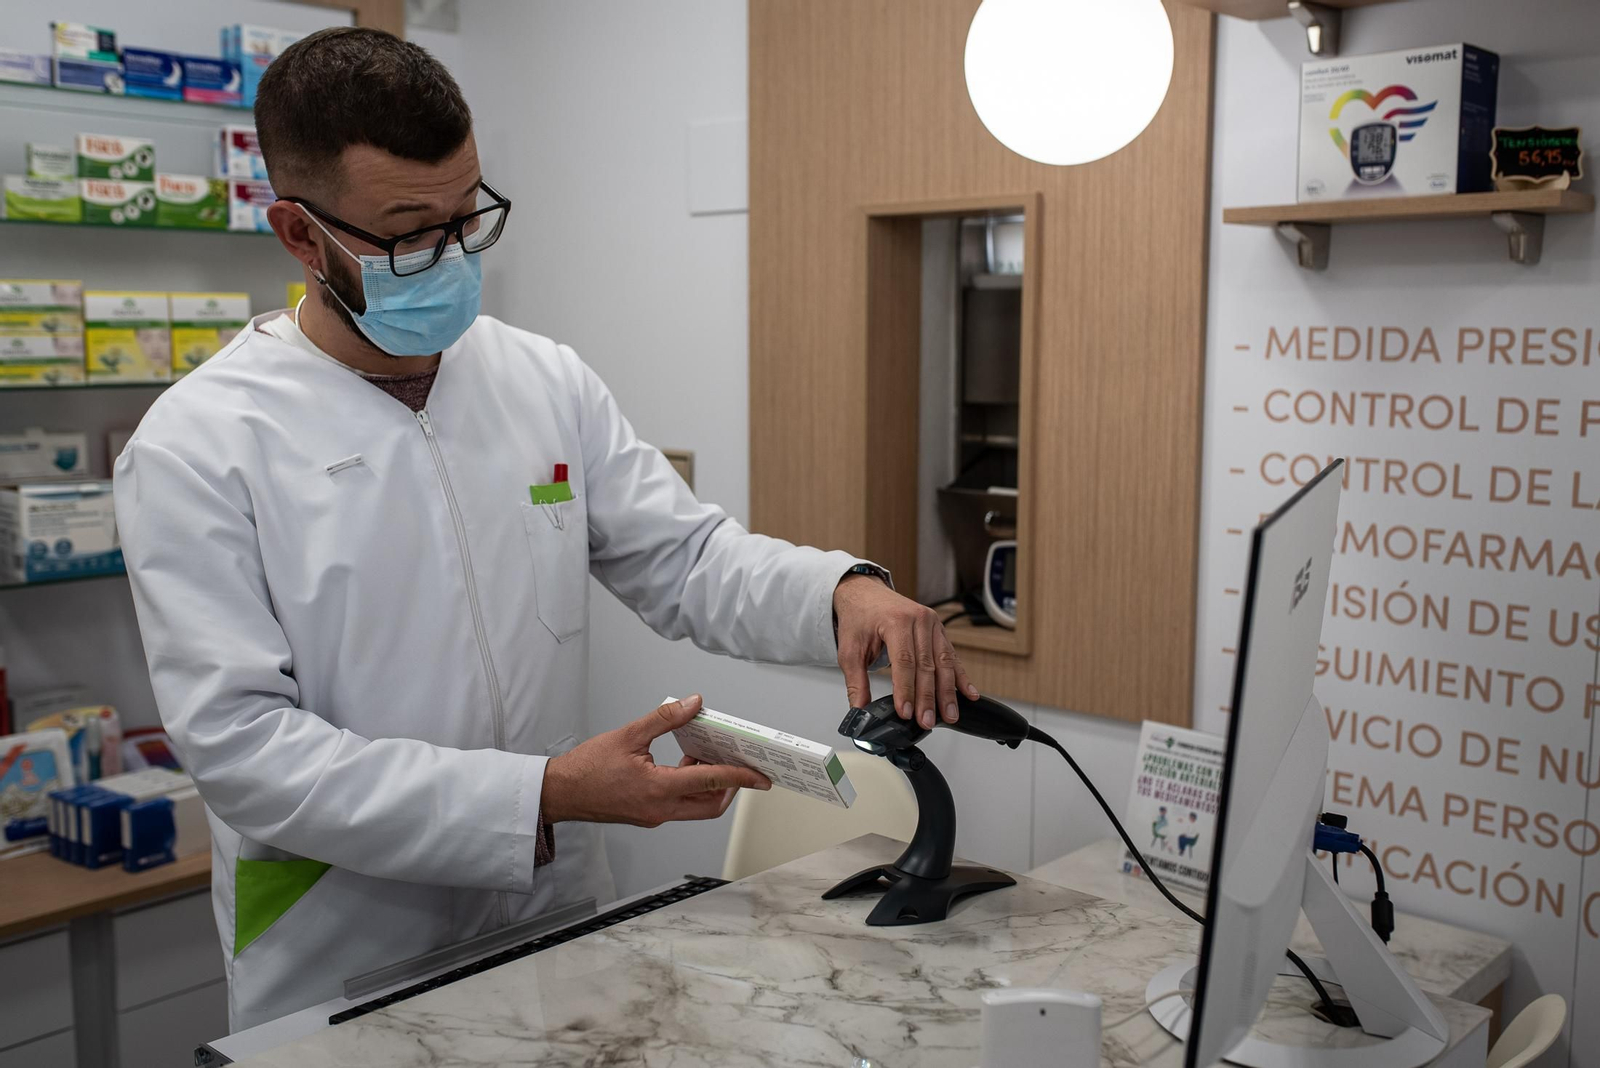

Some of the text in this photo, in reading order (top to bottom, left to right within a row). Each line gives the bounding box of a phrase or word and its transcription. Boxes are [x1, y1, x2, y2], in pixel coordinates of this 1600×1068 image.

[1406, 49, 1458, 65] visomat
[1264, 326, 1600, 366] MEDIDA PRESI
[1264, 388, 1480, 432] CONTROL
[1496, 396, 1561, 436] DE
[1489, 465, 1552, 507] DE
[1571, 471, 1600, 512] L
[1259, 512, 1600, 581] MOFARMA
[1331, 580, 1449, 632] ISIÓN
[1468, 598, 1530, 642] DE
[1324, 706, 1442, 758] VICIO
[1459, 730, 1521, 776] DE
[1442, 791, 1600, 857] PERSO
